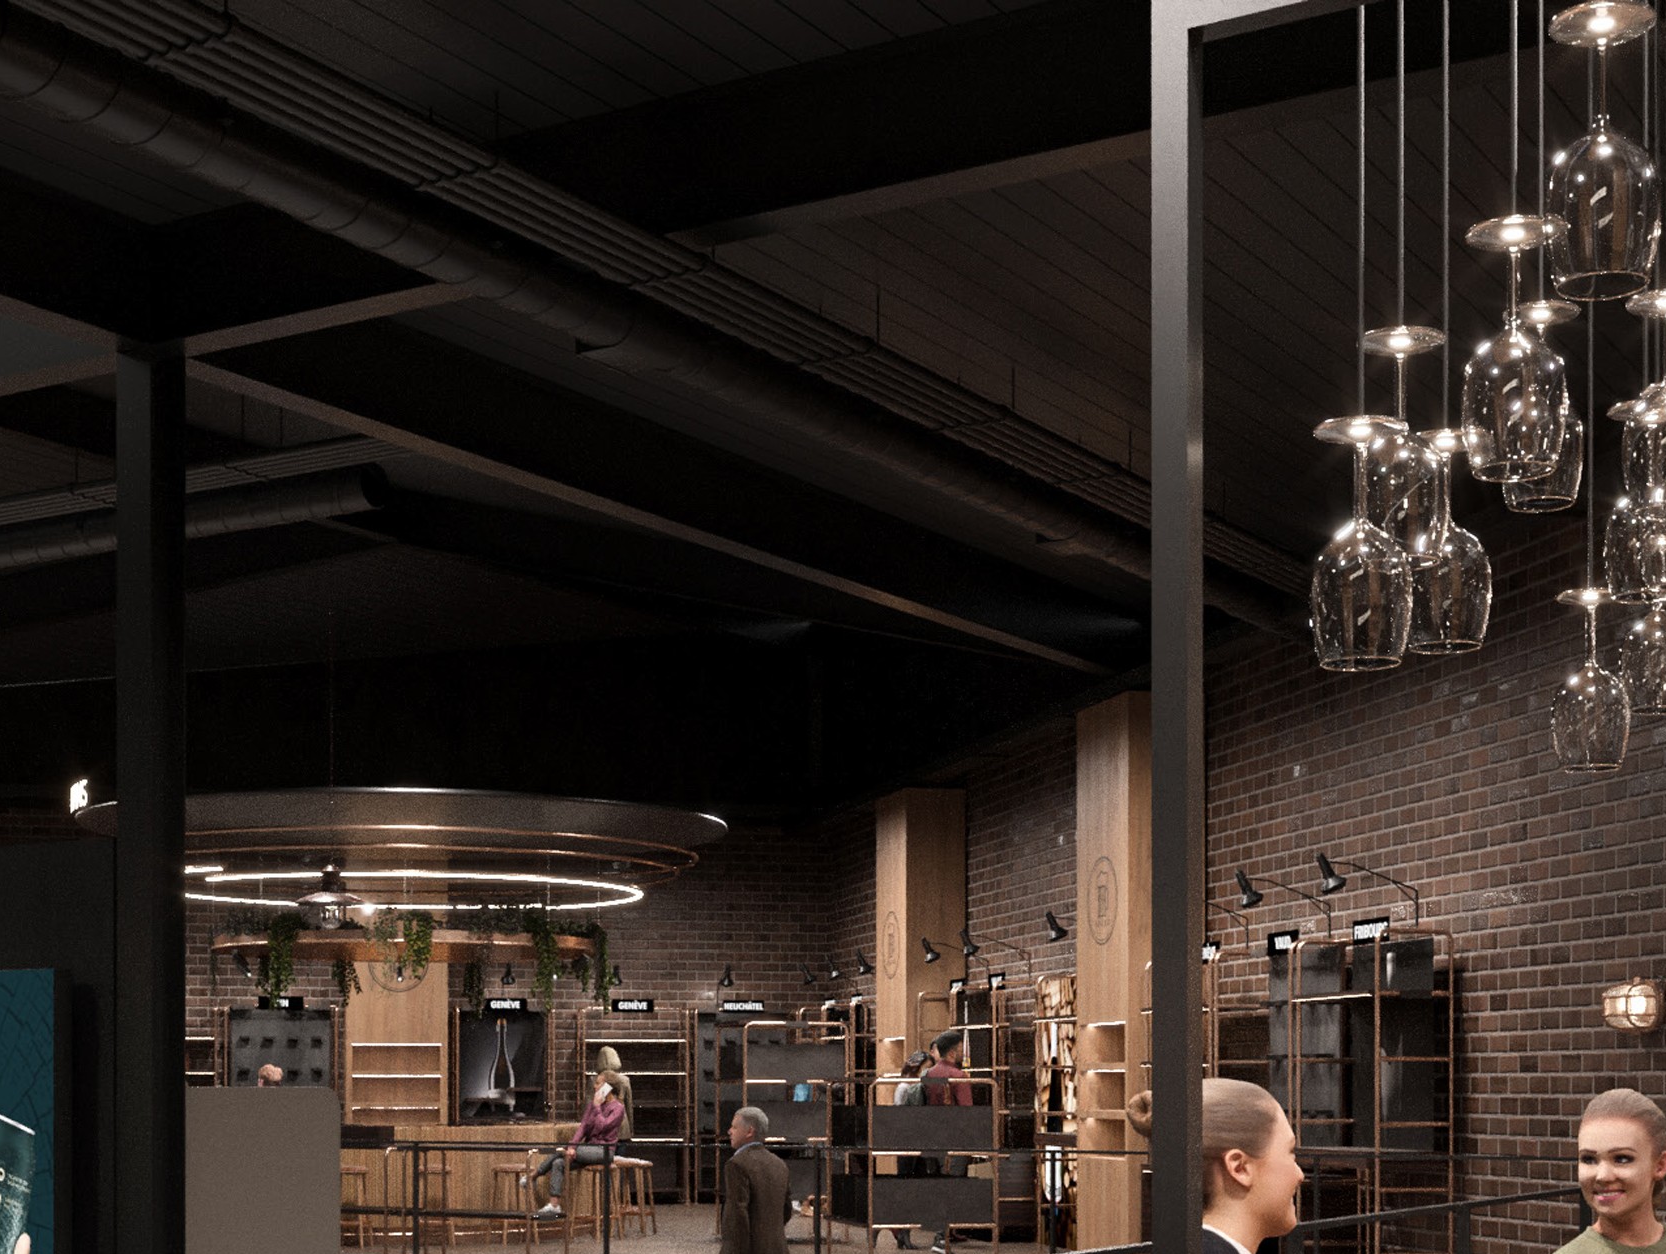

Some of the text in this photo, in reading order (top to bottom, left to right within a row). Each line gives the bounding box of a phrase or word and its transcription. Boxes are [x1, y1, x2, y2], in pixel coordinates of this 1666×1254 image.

[490, 999, 521, 1010] GENÈVE
[618, 1000, 648, 1010] GENÈVE
[723, 1001, 764, 1011] NEUCHÂTEL
